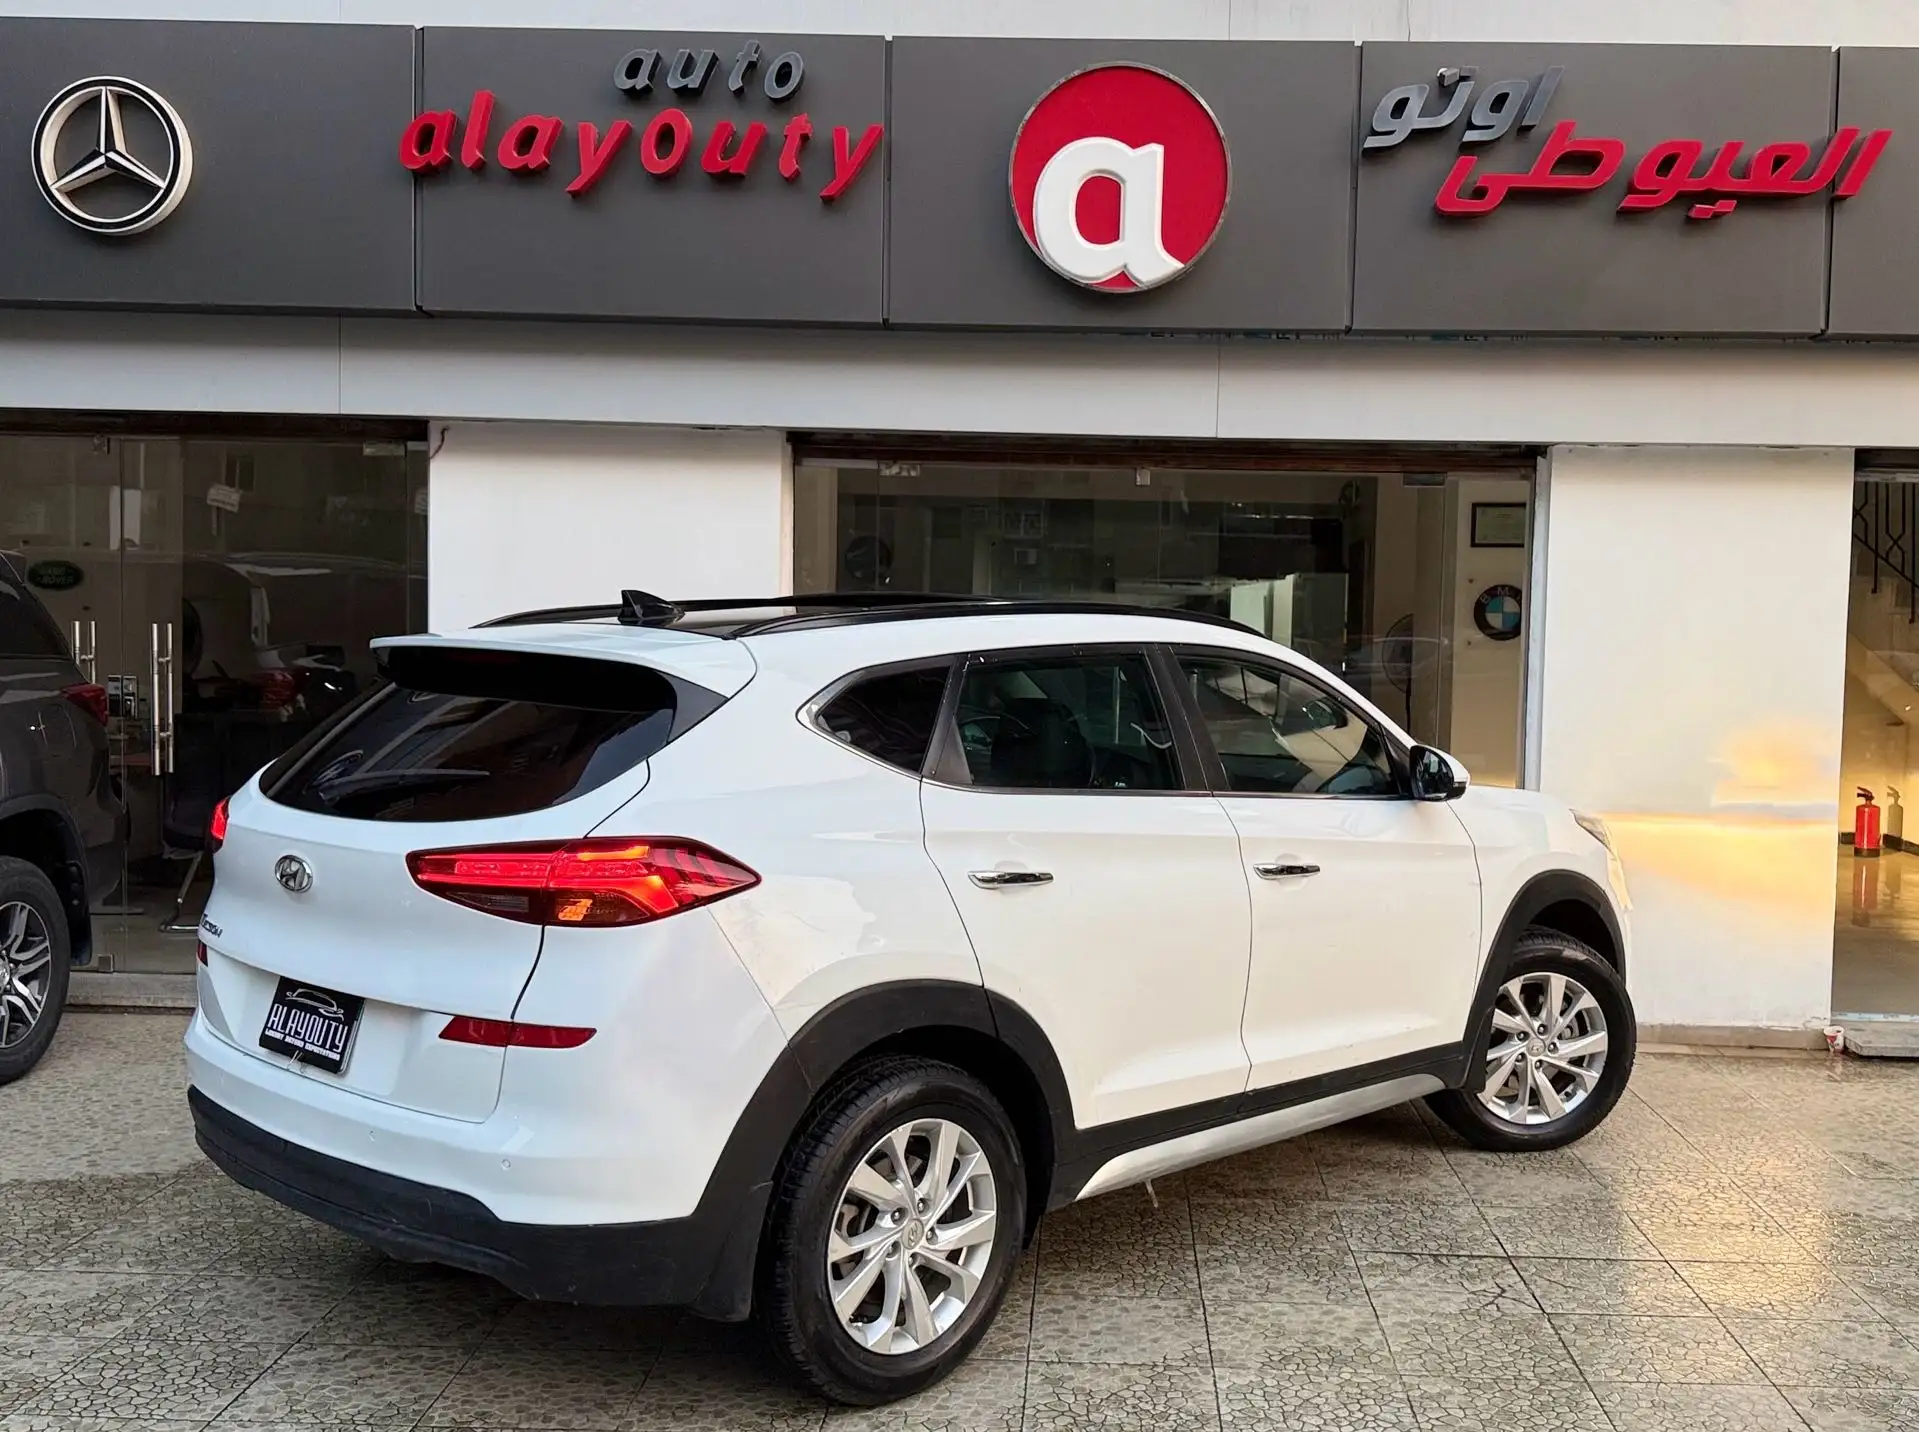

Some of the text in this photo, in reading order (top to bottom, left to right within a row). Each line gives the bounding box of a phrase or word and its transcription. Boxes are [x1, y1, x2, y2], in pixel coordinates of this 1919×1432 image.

[614, 39, 805, 103] auto
[1362, 66, 1565, 150] اوتو
[400, 89, 884, 203] alayouty
[1033, 136, 1185, 289] a
[267, 1003, 348, 1053] ALAYOUTY
